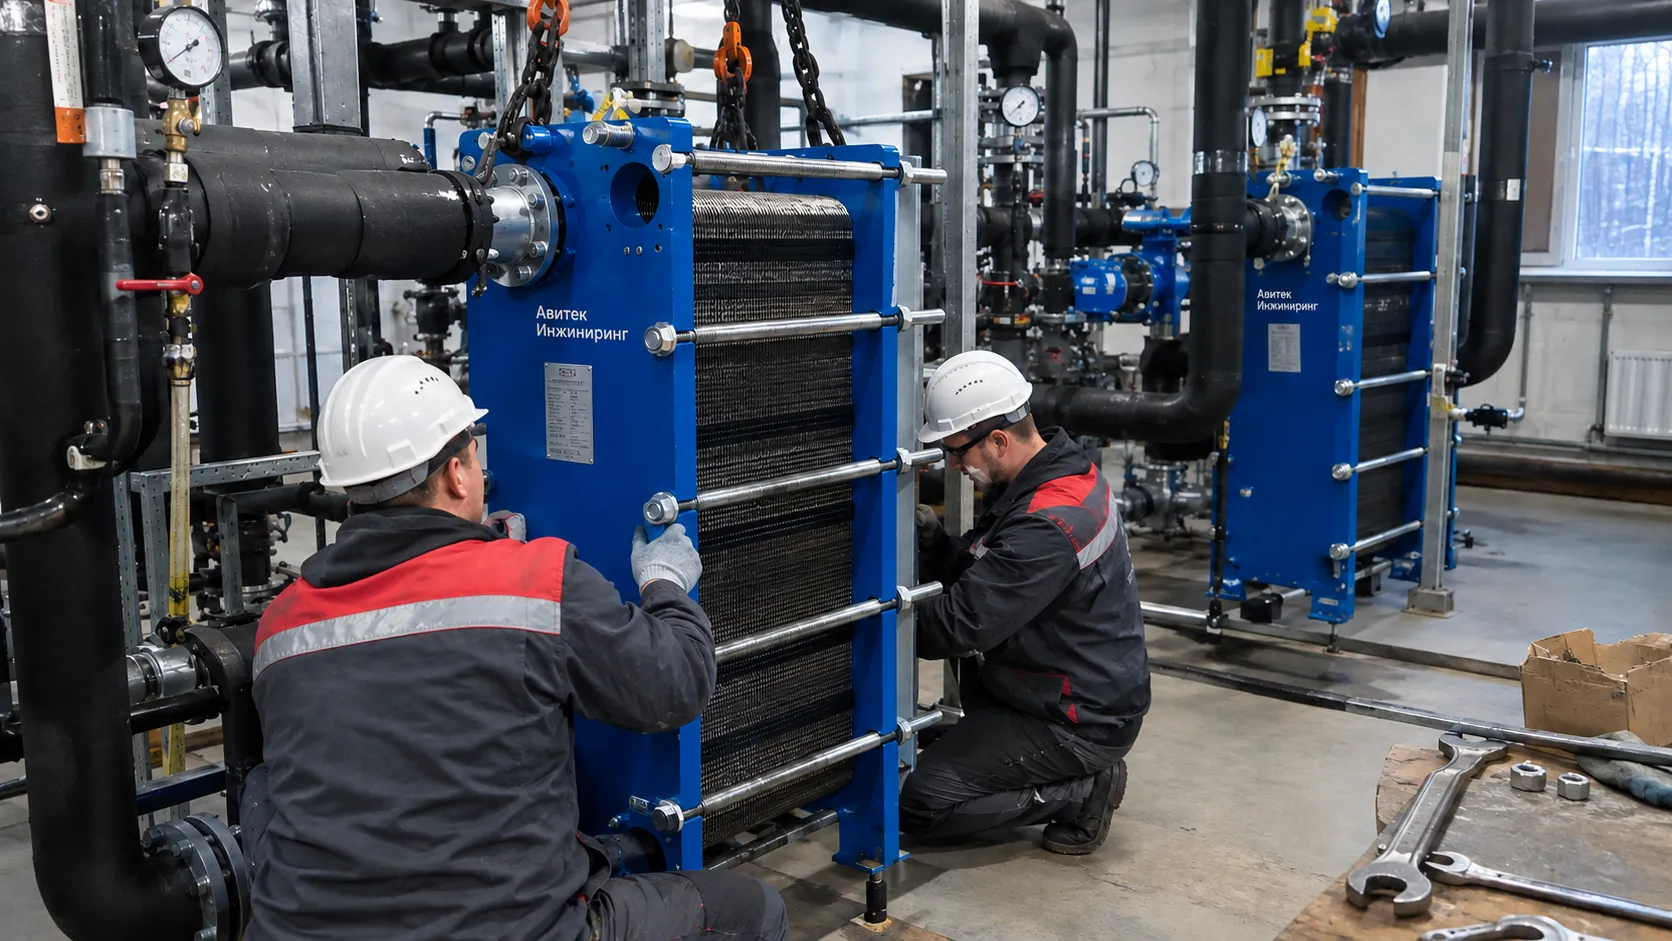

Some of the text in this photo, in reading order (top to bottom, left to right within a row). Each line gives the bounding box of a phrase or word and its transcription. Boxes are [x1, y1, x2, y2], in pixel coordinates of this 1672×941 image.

[1257, 289, 1292, 299] Авитек
[536, 305, 588, 321] Авитек
[1257, 301, 1318, 313] Инжиниринг
[536, 323, 628, 343] Инжиниринг
